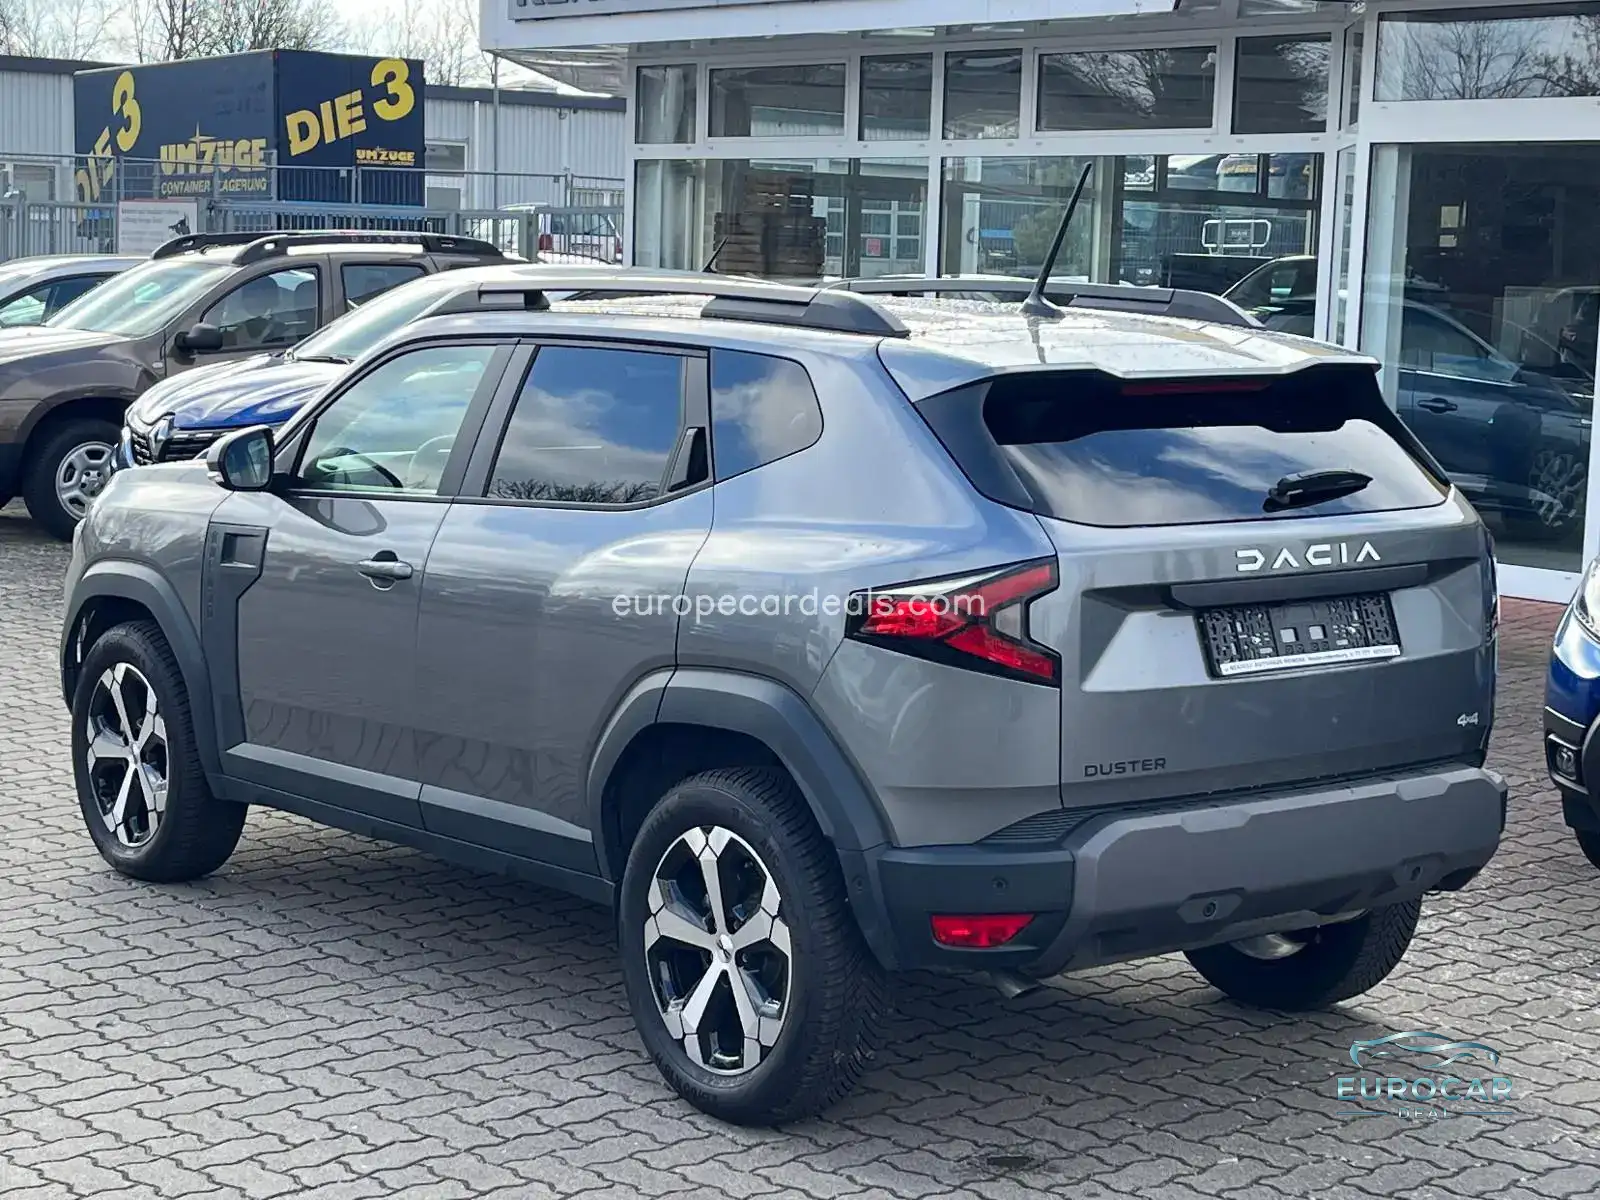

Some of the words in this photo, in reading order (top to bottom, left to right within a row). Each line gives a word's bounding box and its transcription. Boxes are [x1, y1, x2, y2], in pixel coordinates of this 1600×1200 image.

[112, 70, 141, 152] 3
[286, 89, 367, 156] DIE
[371, 58, 415, 121] 3
[160, 138, 266, 176] UMZÜGE
[161, 180, 211, 195] CONTAINER
[1236, 541, 1381, 571] DACIA
[1457, 712, 1479, 727] 4x4
[1083, 757, 1167, 777] DUSTER
